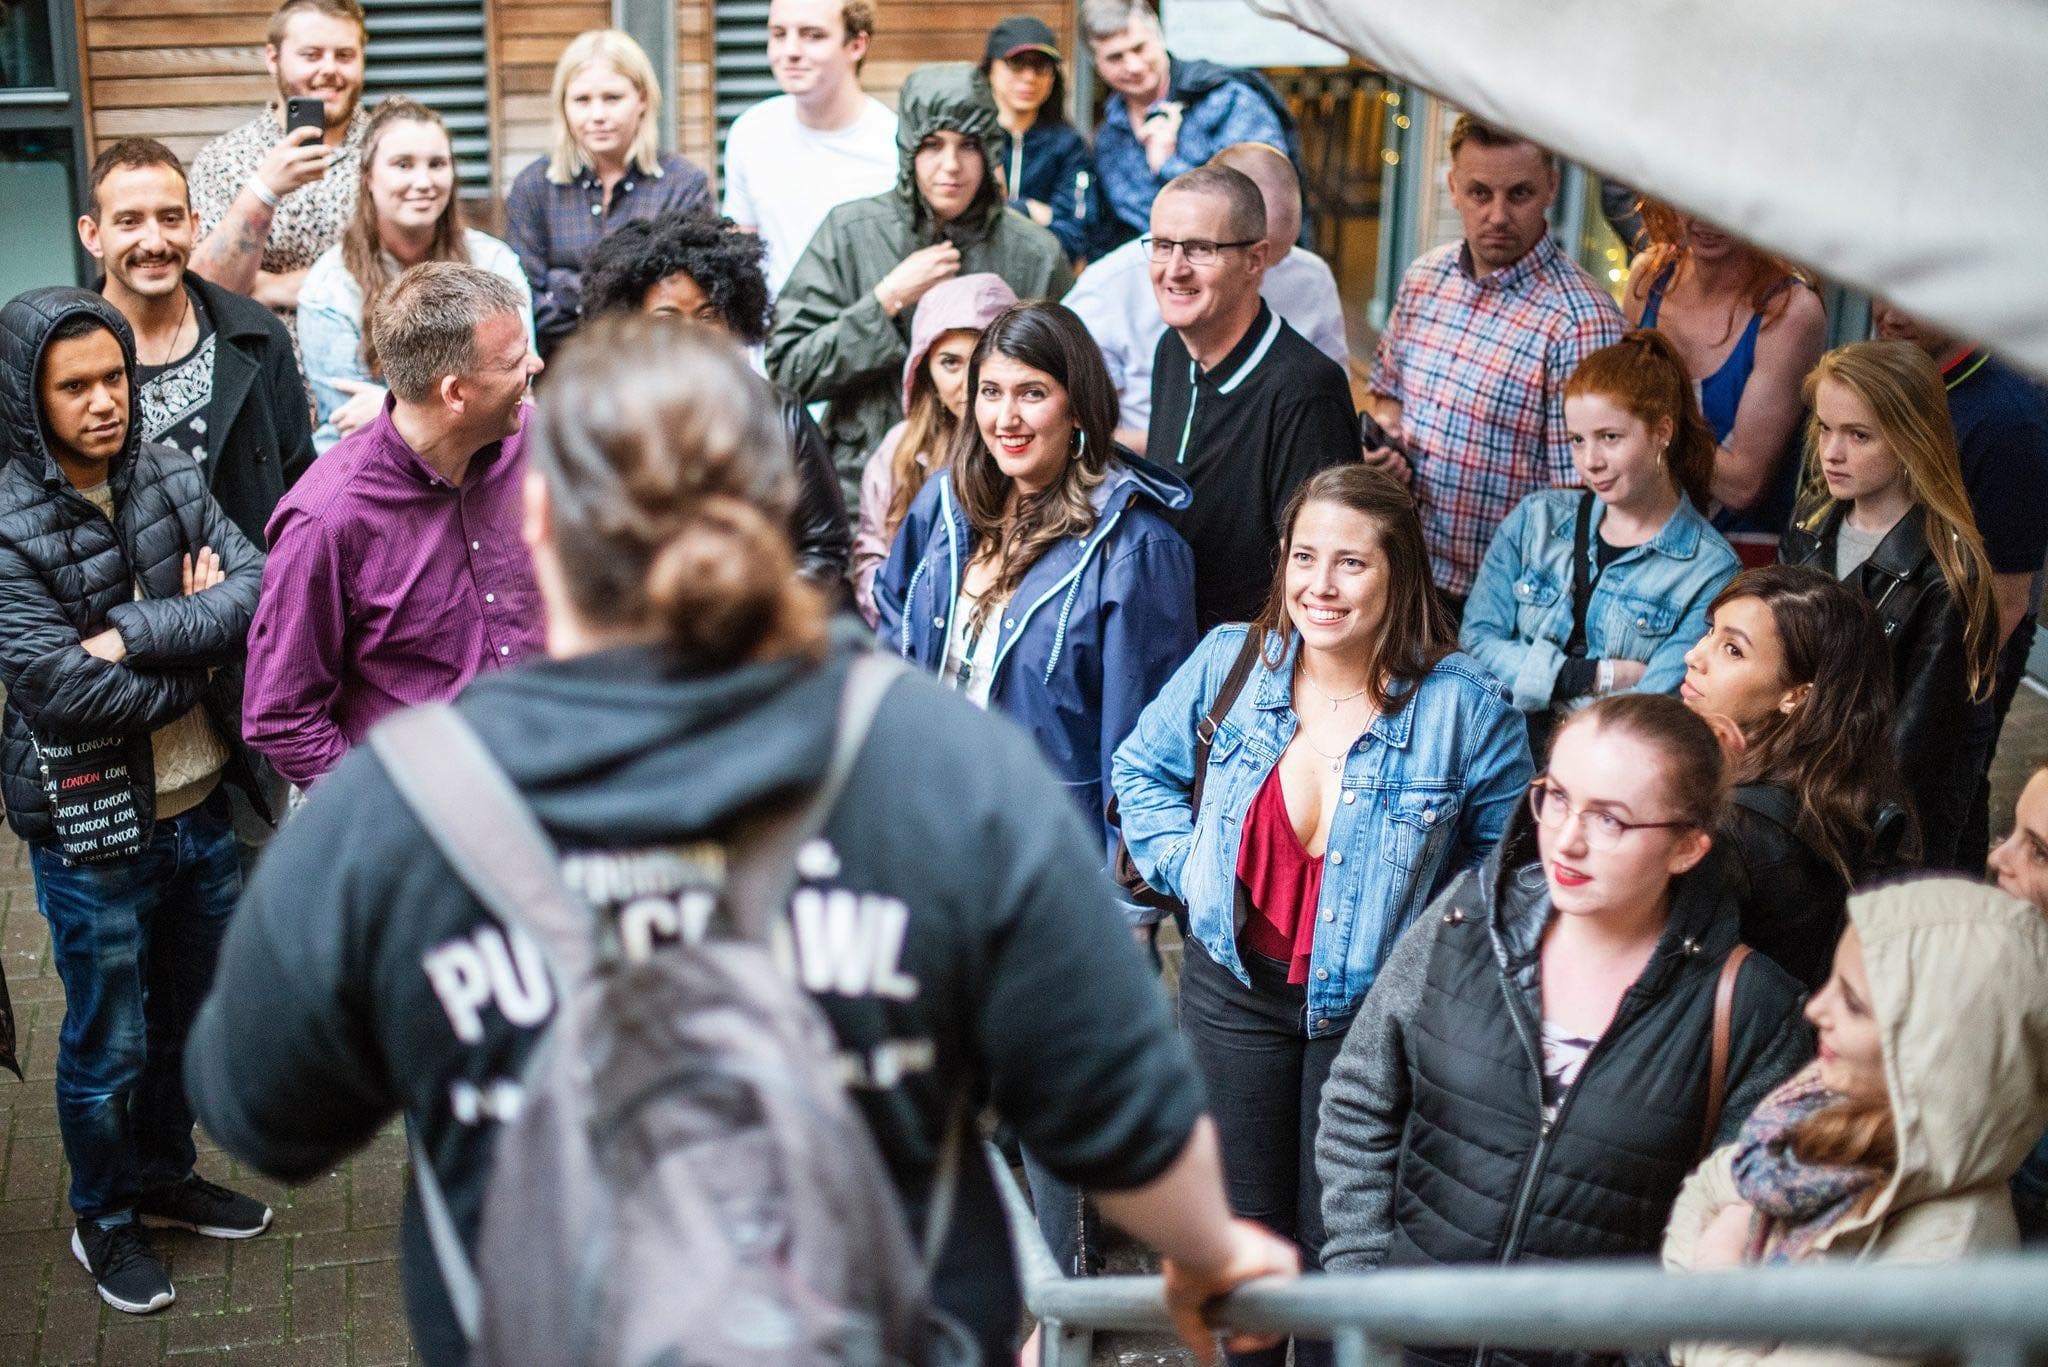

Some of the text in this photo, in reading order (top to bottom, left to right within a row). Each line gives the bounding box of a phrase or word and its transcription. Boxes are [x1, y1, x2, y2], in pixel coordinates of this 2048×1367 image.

[61, 771, 101, 789] LONDON
[93, 790, 131, 811] LONDON
[70, 816, 110, 835] LONDON
[103, 826, 140, 846] LONDON
[422, 924, 557, 1044] PU
